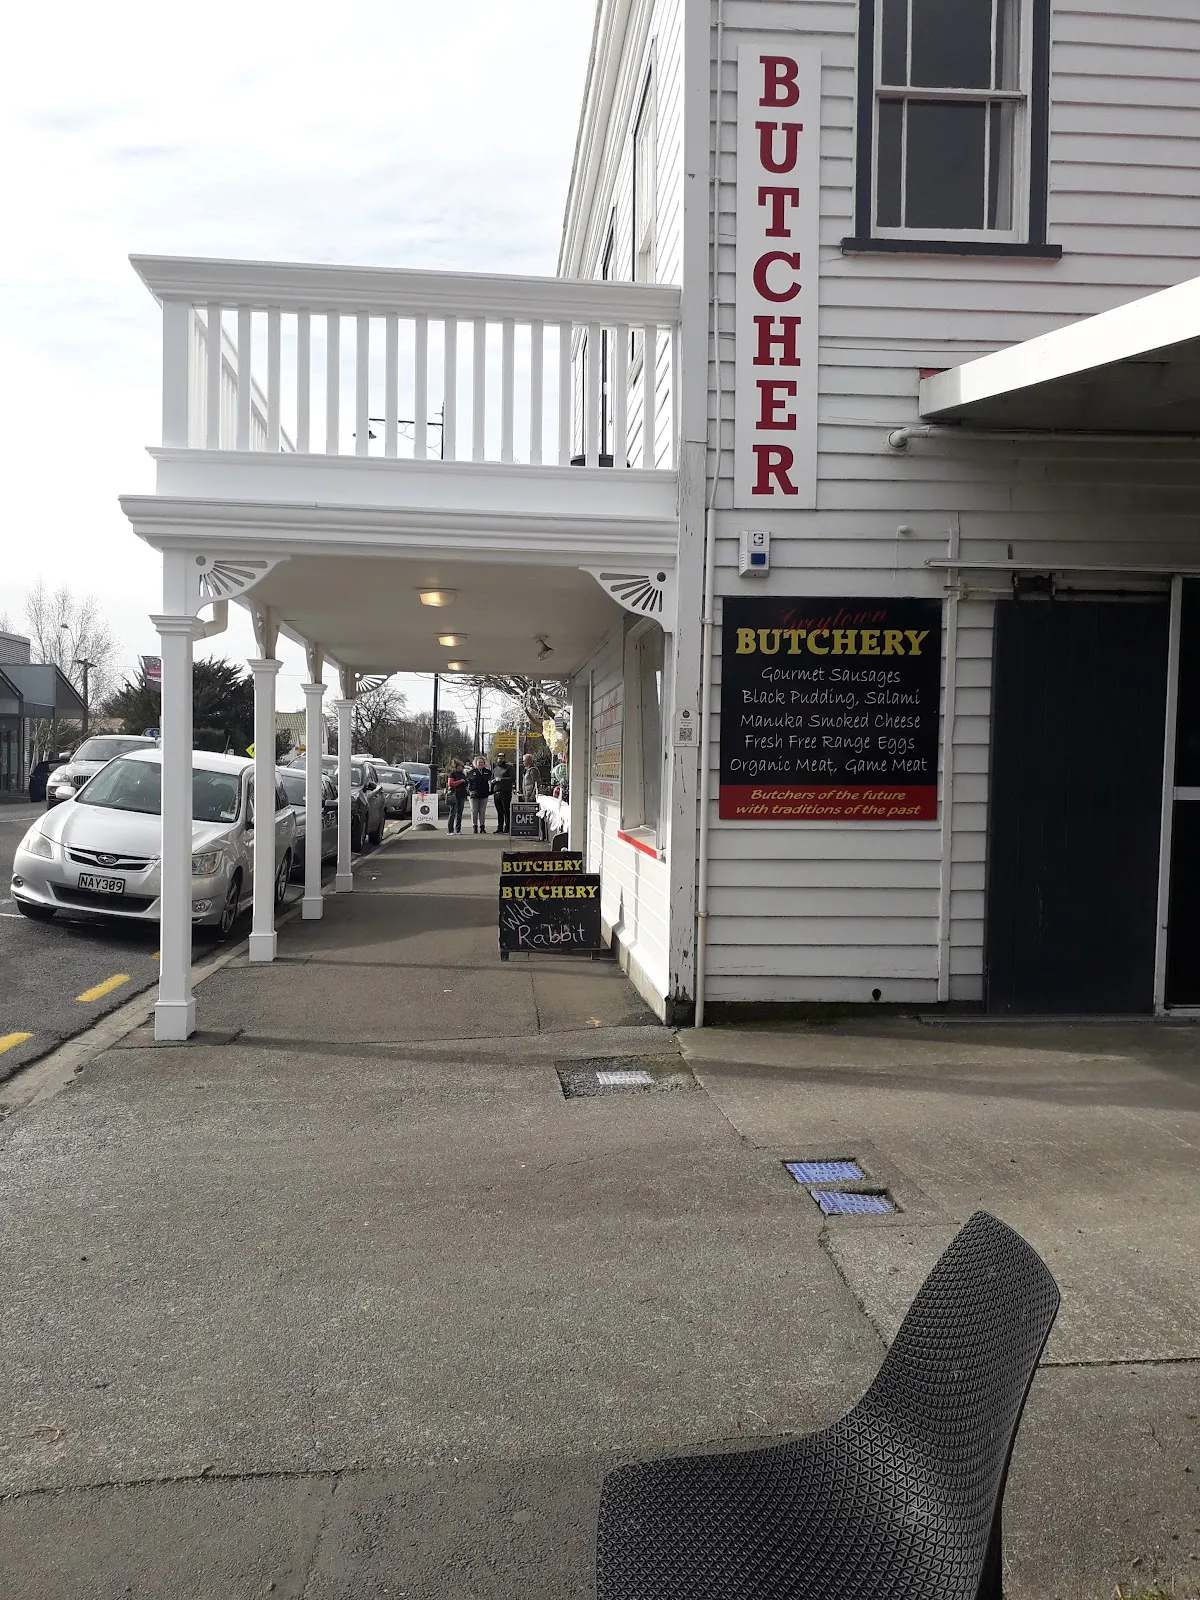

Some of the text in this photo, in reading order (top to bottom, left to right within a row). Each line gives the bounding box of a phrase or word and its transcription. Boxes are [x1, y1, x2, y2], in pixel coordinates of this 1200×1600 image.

[751, 55, 803, 495] BUTCHER
[735, 628, 930, 656] BUTCHERY
[761, 666, 901, 688] Gourmet Sausages
[742, 689, 921, 710] Black Pudding, Salami
[740, 713, 921, 729] Manuka Smoked Cheese
[745, 734, 915, 755] Fresh Free Range Eggs
[730, 756, 928, 777] Organic Meat, Game Meat
[751, 790, 906, 803] Butchers of the future
[736, 804, 921, 819] with traditions of the past
[502, 860, 582, 873] BUTCHERY
[80, 875, 123, 891] NAY309
[501, 885, 599, 899] BUTCHERY
[503, 899, 541, 931] Wild
[518, 922, 585, 949] Rabbit
